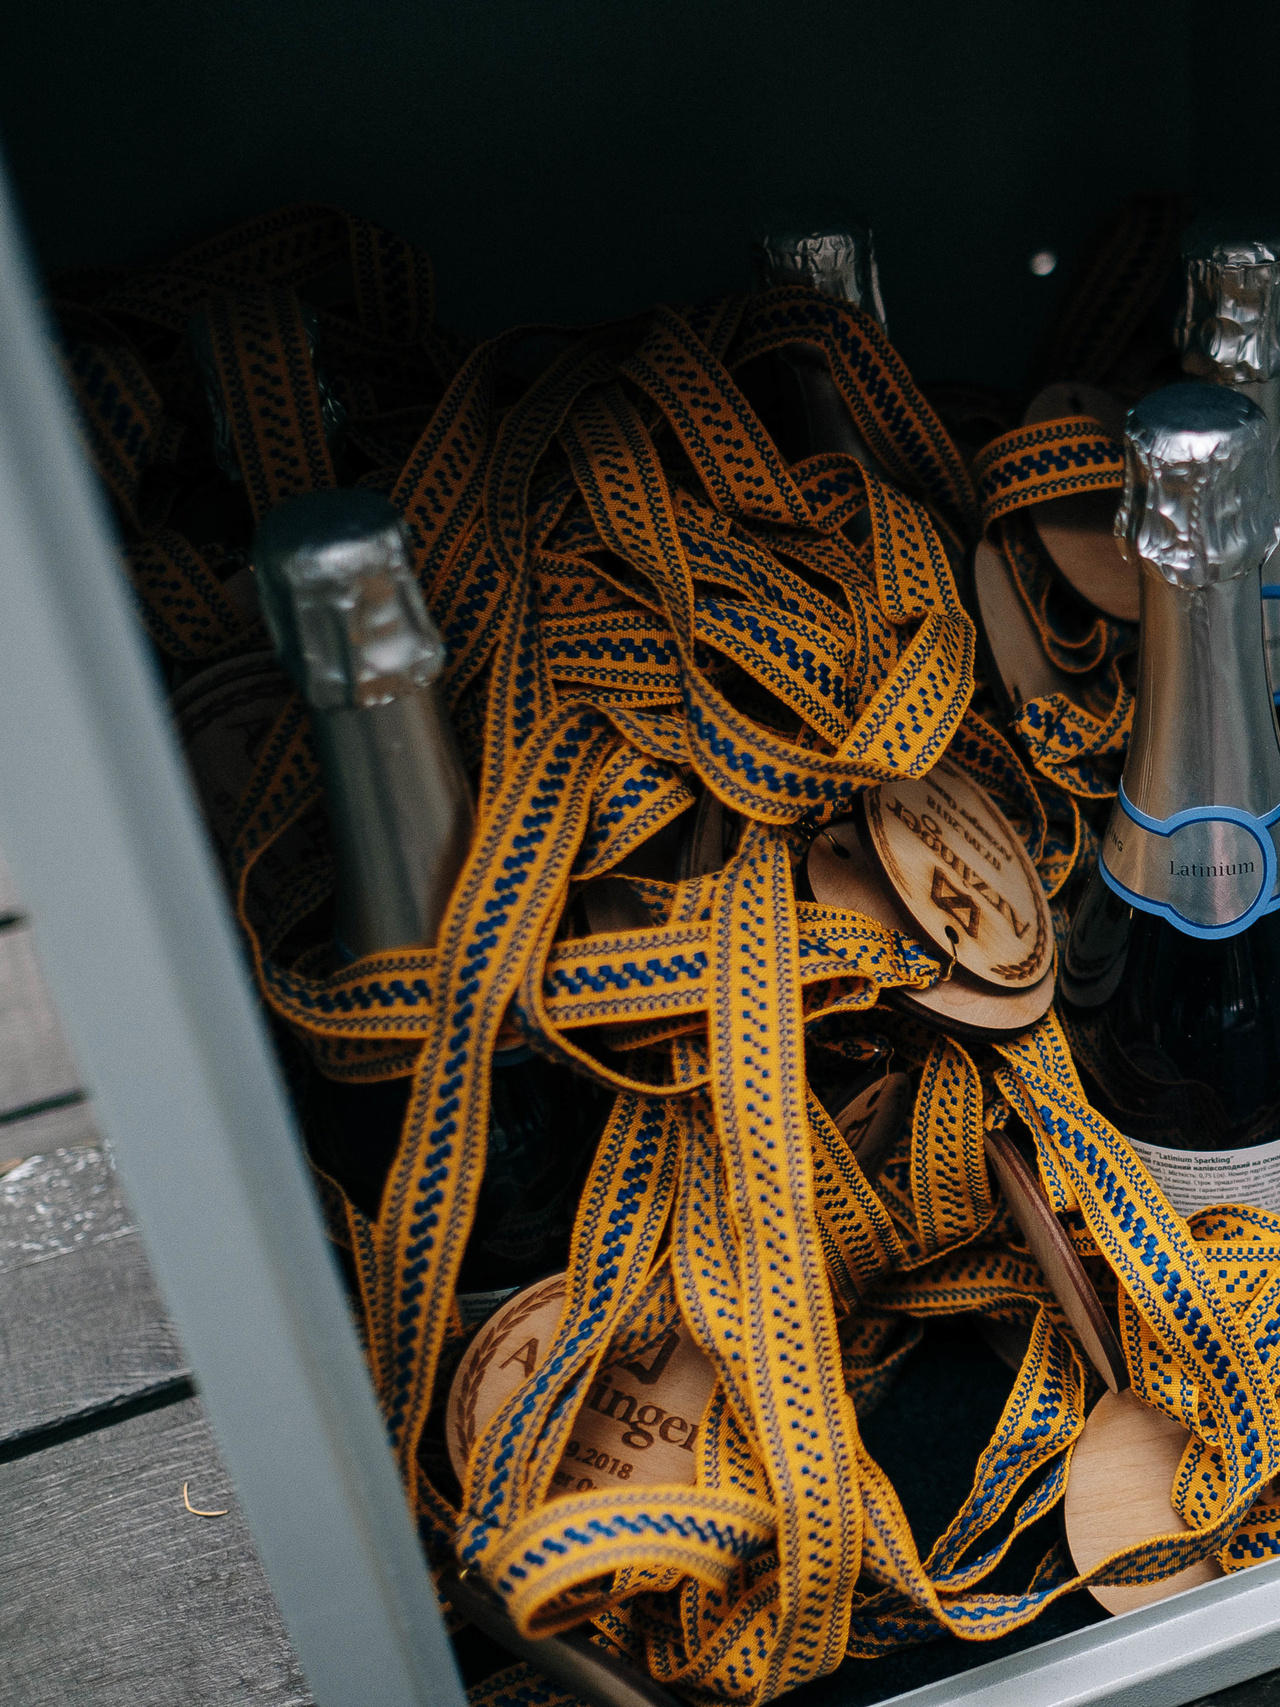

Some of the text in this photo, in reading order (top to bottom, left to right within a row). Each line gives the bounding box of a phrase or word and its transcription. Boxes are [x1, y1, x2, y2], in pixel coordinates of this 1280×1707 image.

[886, 796, 1029, 940] Arzinger
[1170, 860, 1255, 877] Latinium
[565, 1441, 633, 1480] 9.2018
